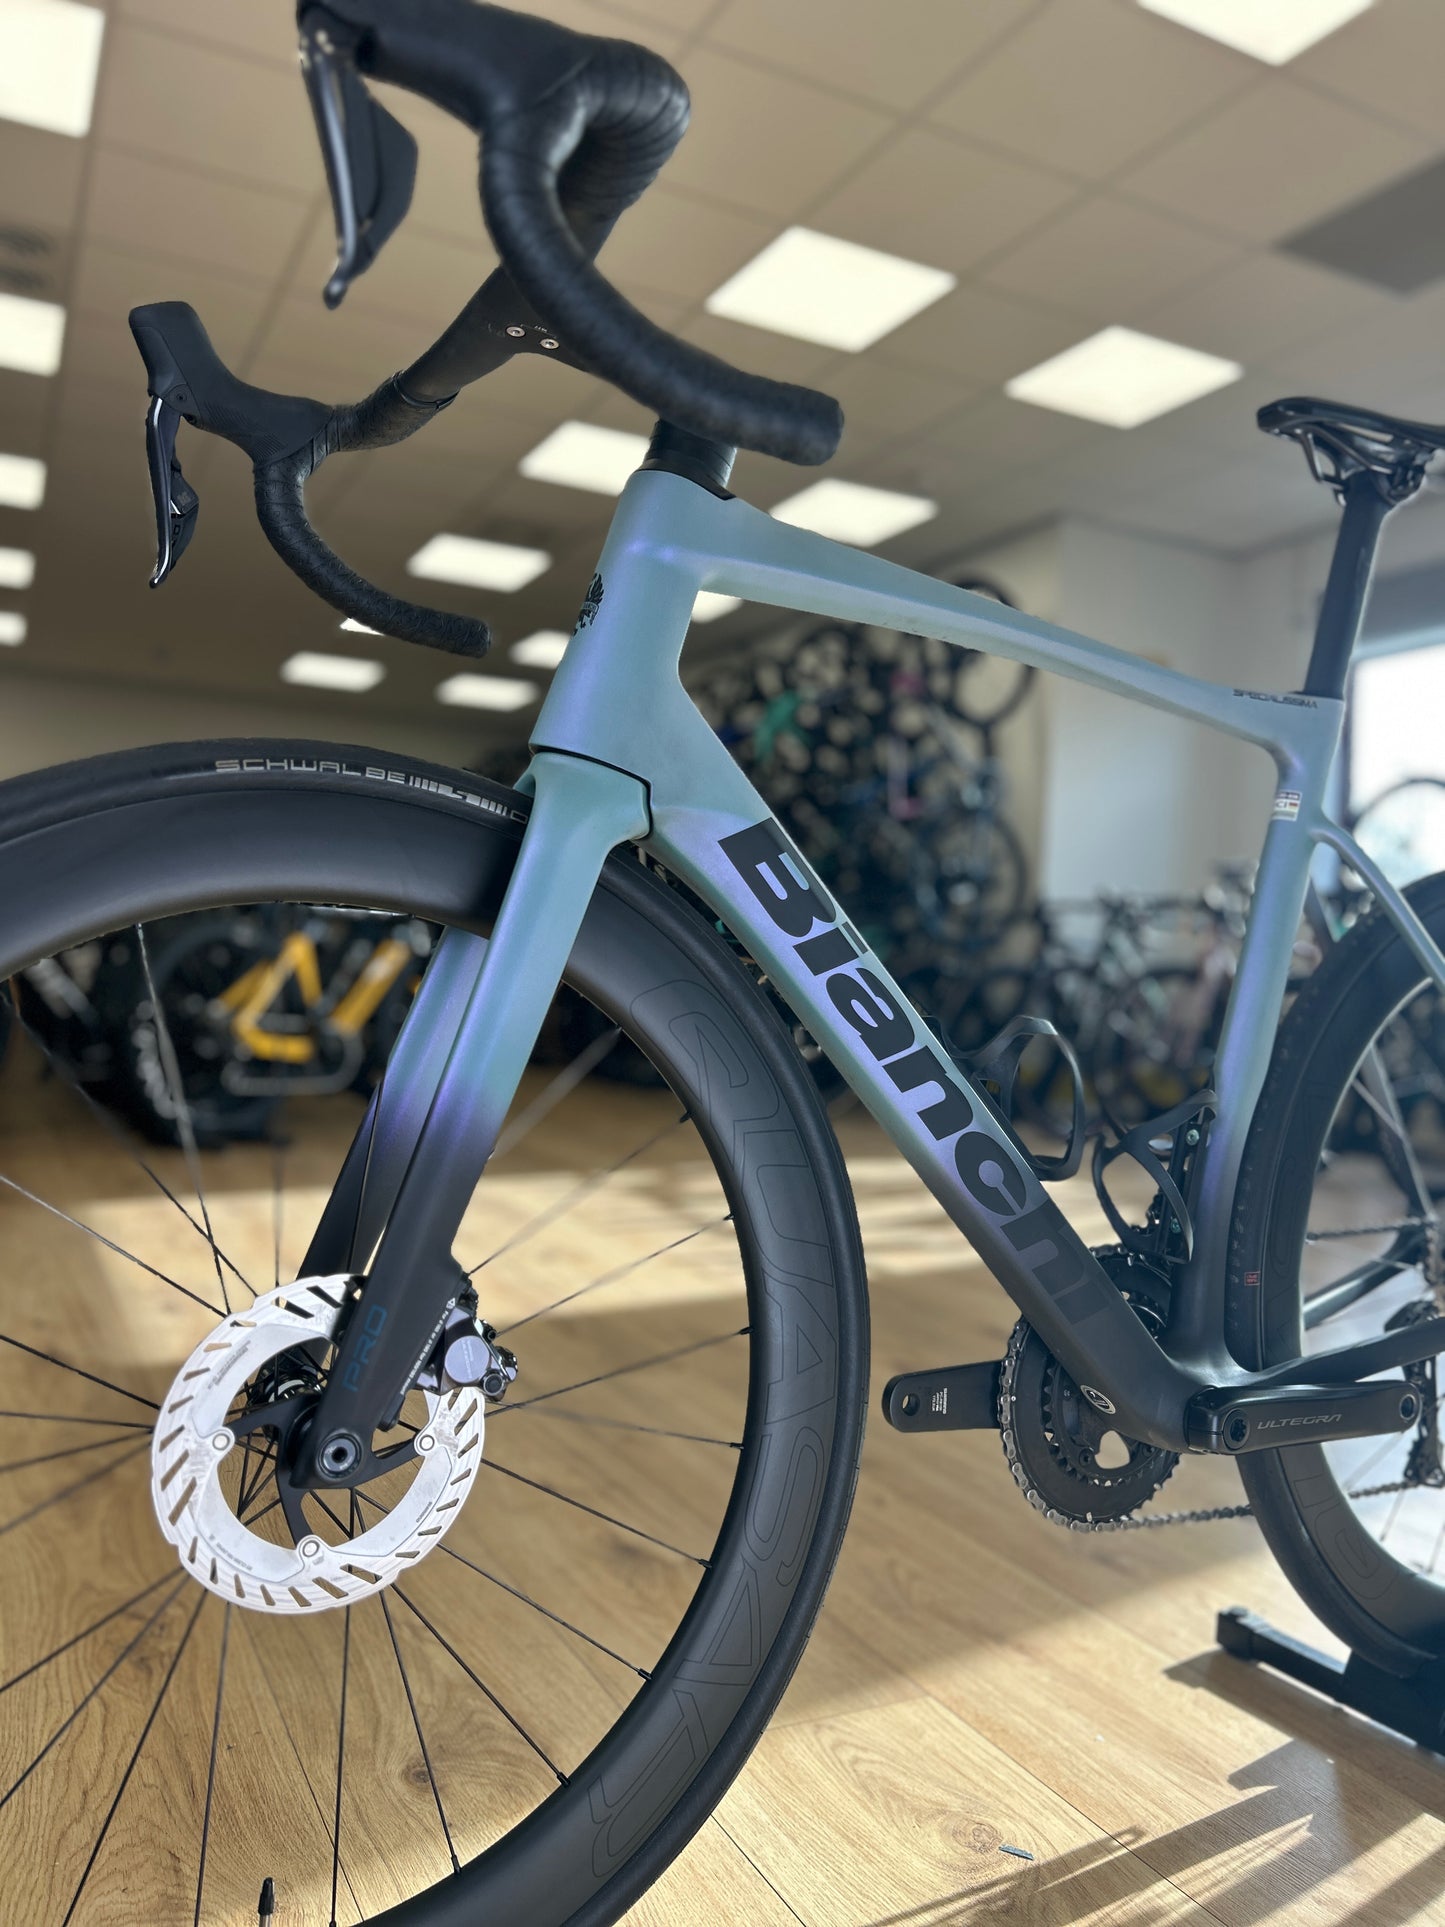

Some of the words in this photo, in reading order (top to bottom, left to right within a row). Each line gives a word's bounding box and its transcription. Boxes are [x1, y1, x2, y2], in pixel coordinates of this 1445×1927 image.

[215, 759, 405, 784] SCHWALBE
[717, 817, 1111, 1325] Bianchi
[343, 1305, 387, 1391] PRO
[1257, 1414, 1341, 1429] ULTEGRA
